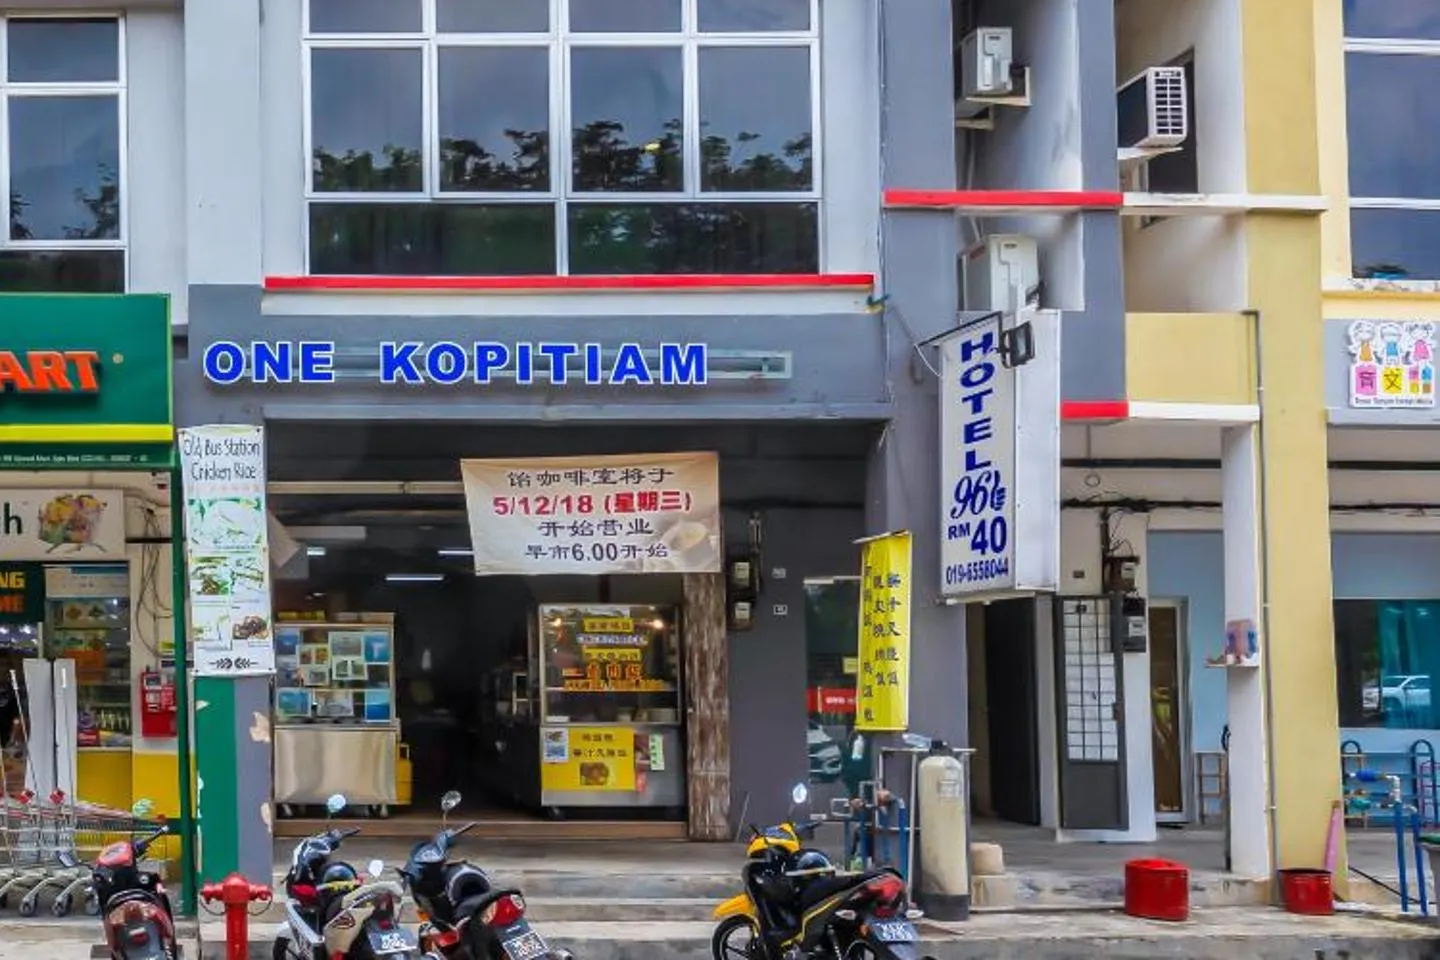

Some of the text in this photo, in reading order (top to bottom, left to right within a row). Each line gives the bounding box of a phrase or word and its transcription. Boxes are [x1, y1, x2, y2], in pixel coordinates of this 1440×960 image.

[204, 341, 708, 385] ONE KOPITIAM
[960, 331, 995, 472] HOTEL
[205, 439, 222, 456] Bus
[224, 438, 260, 456] Station
[234, 462, 257, 479] Rice
[493, 494, 594, 516] 5/12/18
[537, 518, 654, 537] 开始营业
[948, 516, 1008, 556] RM 40
